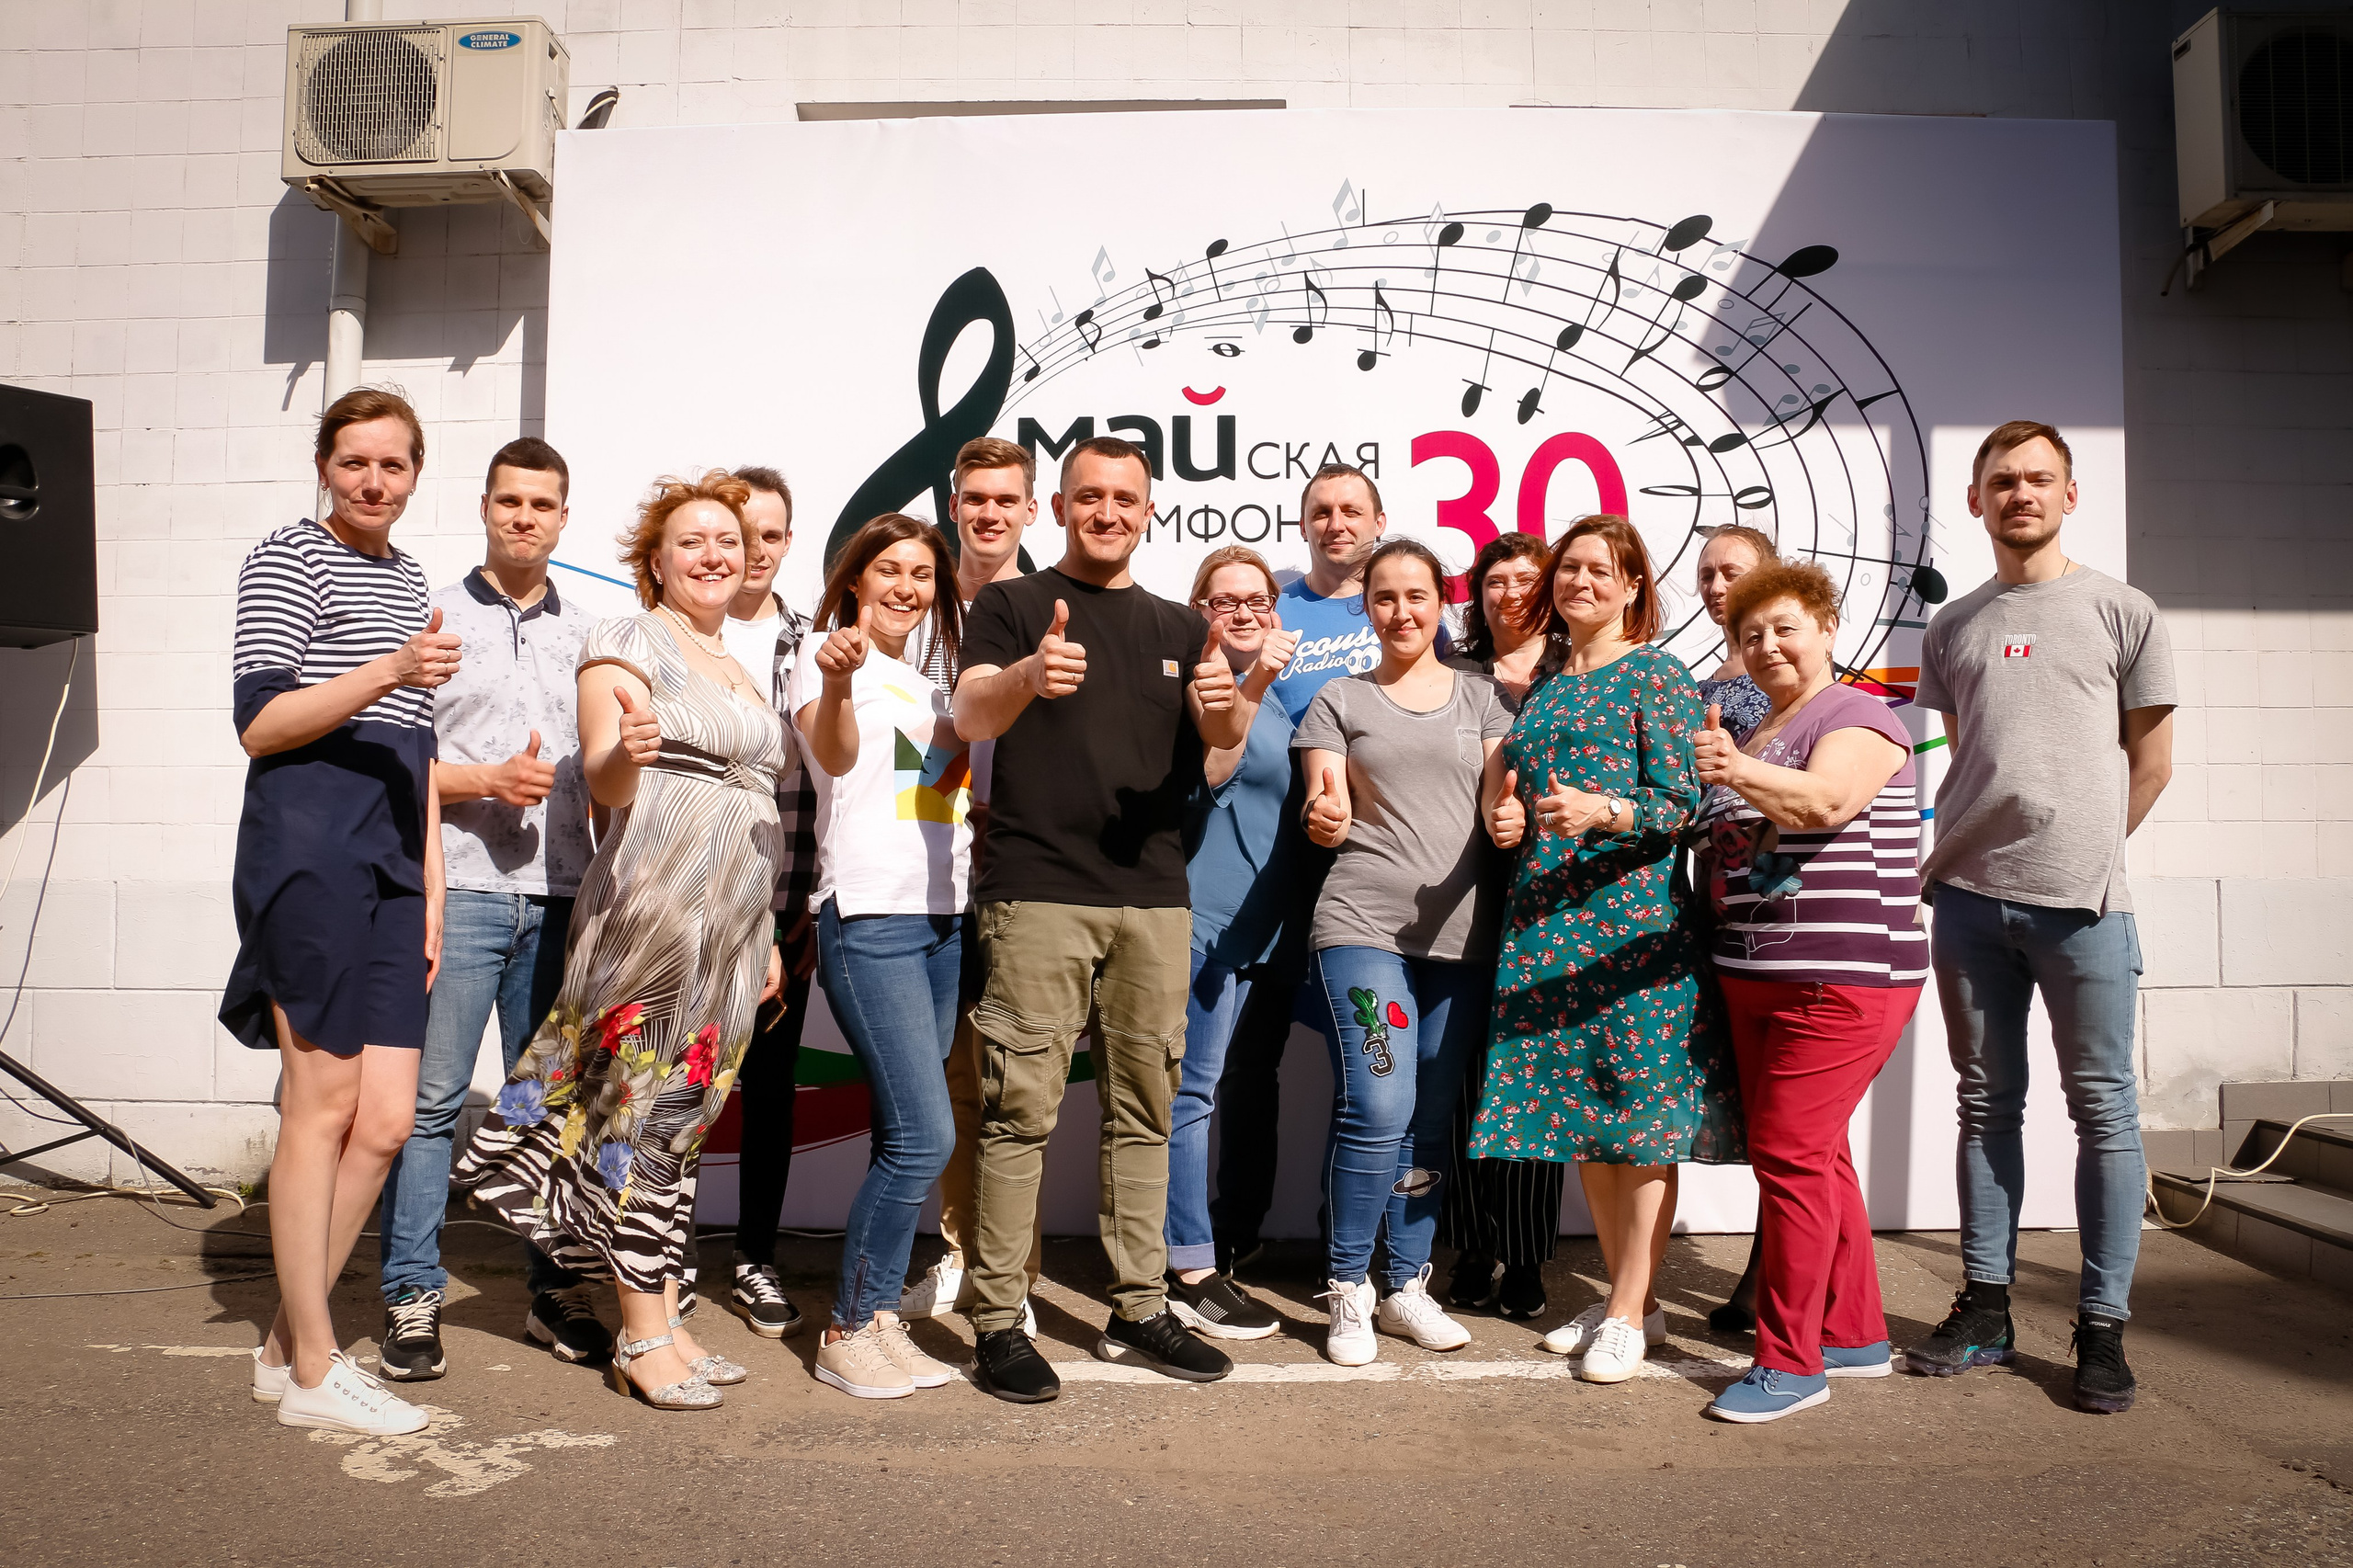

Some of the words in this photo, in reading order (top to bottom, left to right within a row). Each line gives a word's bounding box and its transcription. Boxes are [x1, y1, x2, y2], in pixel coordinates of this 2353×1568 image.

[1411, 430, 1629, 604] 30
[2004, 634, 2036, 645] TORONTO
[1279, 652, 1347, 681] Radio
[1362, 1037, 1394, 1077] 3
